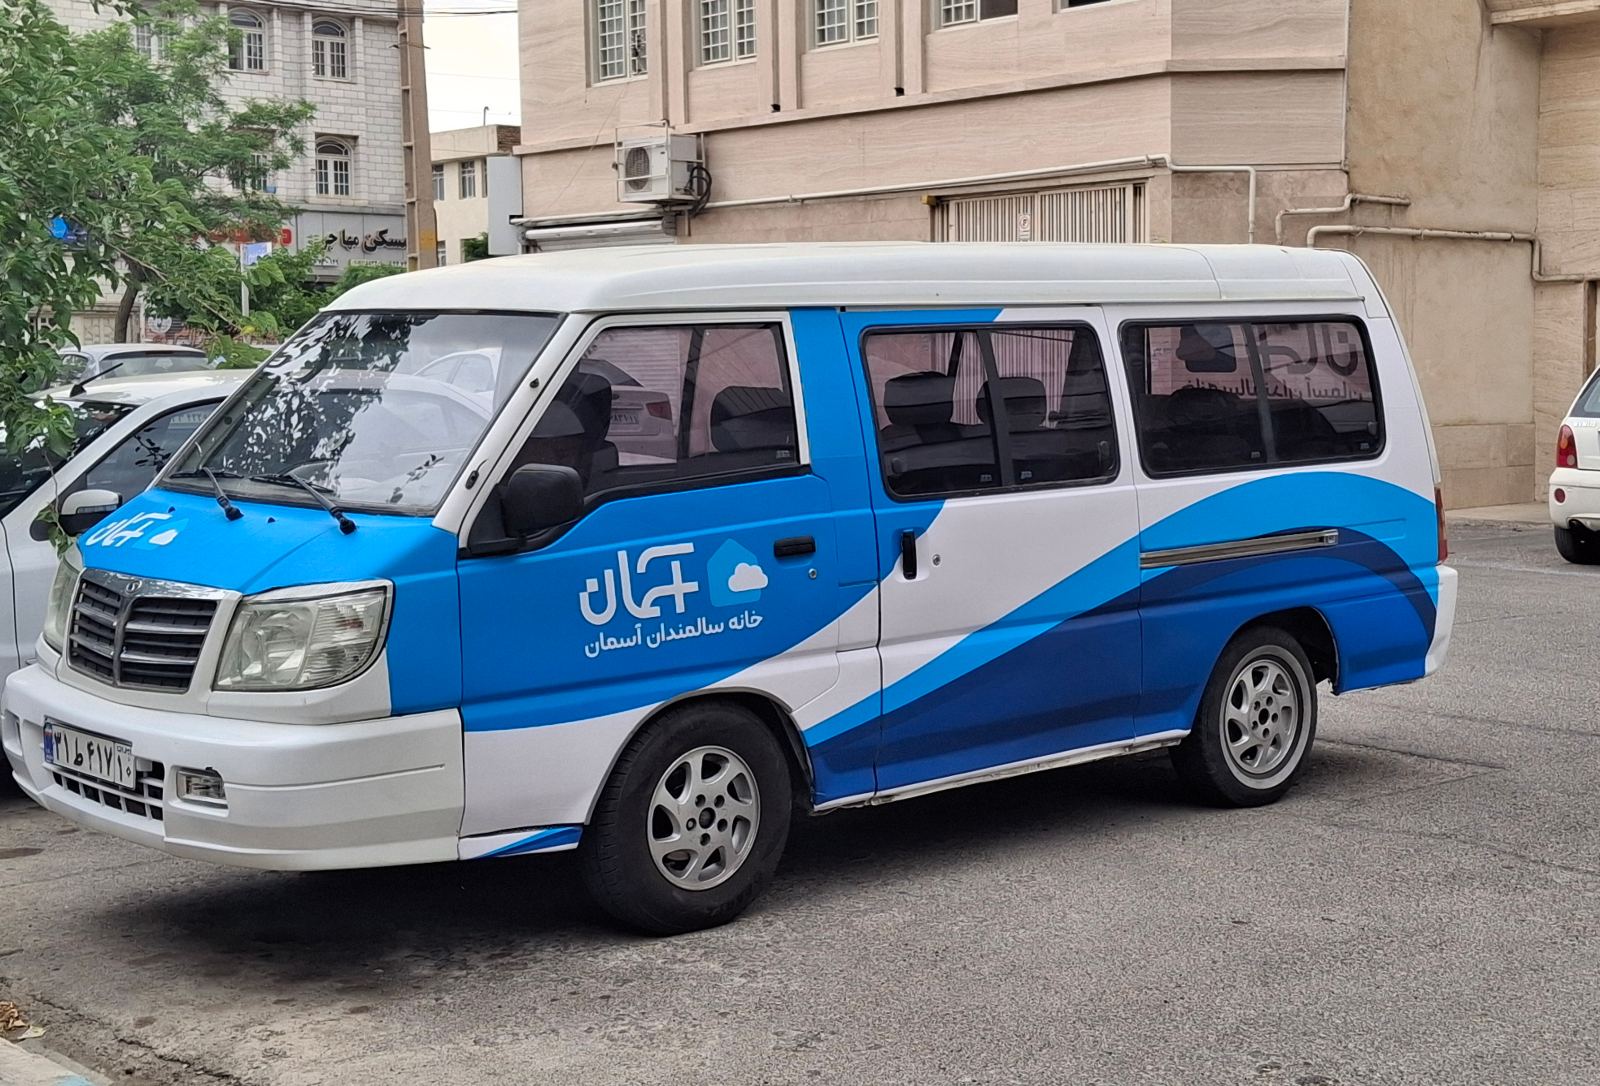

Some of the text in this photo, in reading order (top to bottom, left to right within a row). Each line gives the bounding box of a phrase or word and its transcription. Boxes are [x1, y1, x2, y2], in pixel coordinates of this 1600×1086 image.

[361, 228, 407, 252] سکن
[584, 609, 764, 659] خانه سالمندان آسمان
